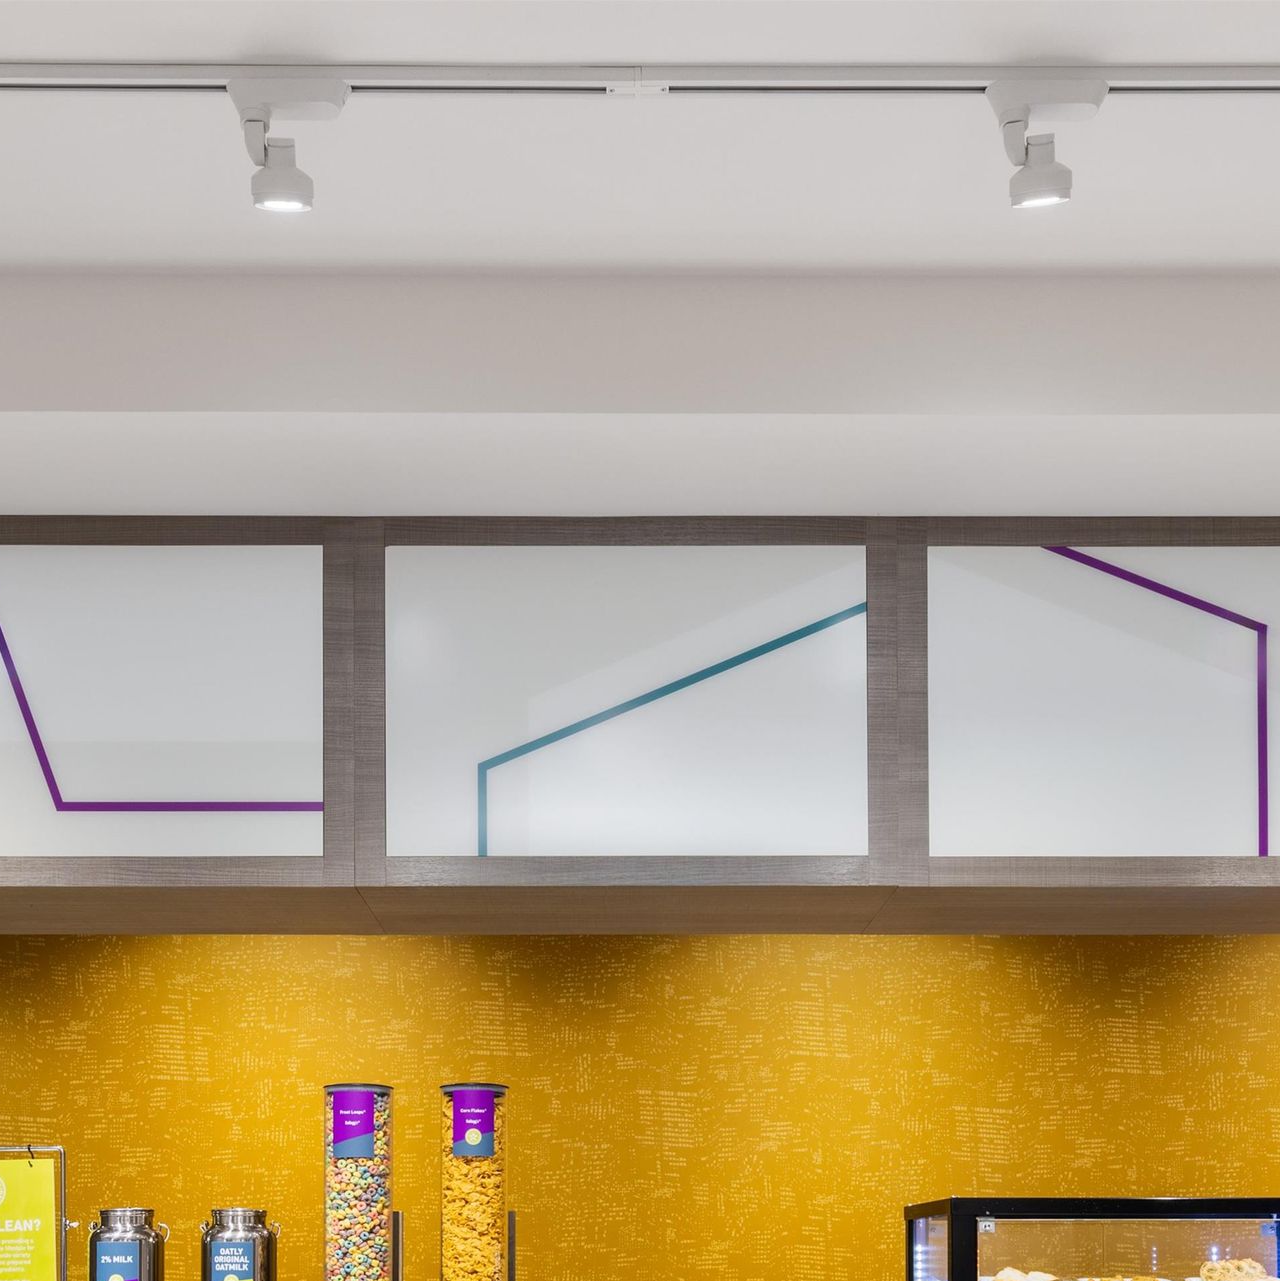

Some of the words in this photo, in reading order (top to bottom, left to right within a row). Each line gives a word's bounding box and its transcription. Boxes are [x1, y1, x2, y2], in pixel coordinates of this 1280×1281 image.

[219, 1247, 244, 1255] OATLY
[112, 1255, 133, 1263] MILK
[214, 1255, 249, 1263] ORIGINAL
[215, 1263, 249, 1271] OATMILK
